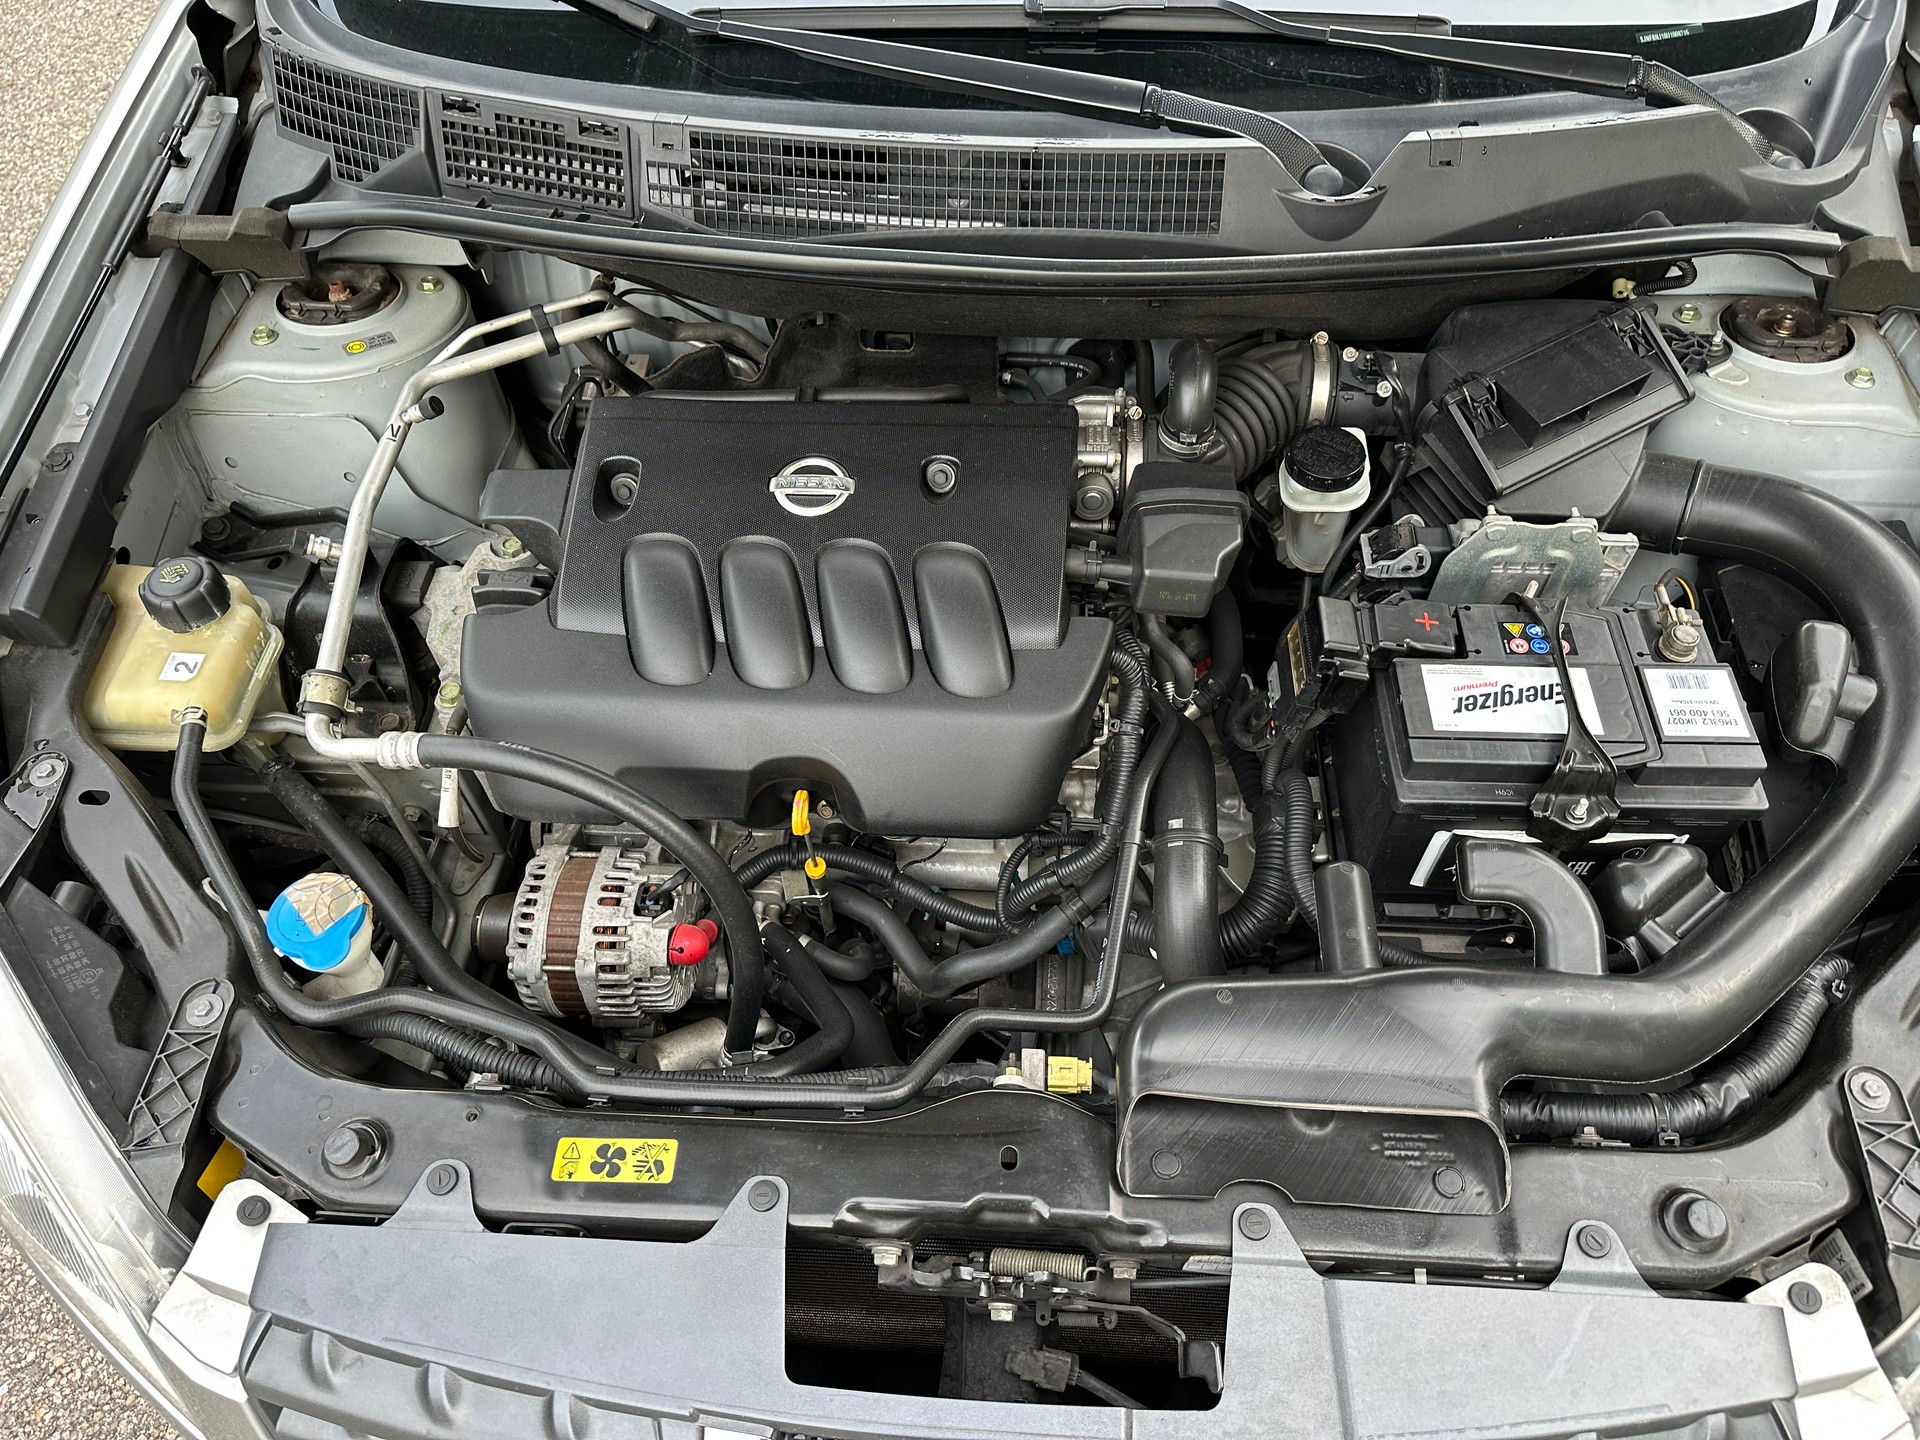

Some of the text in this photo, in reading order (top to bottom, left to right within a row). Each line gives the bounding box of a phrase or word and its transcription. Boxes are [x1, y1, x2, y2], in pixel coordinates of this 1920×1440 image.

[778, 477, 847, 490] NISSAN
[174, 661, 199, 674] 2
[1453, 680, 1498, 692] Premium
[1453, 682, 1565, 715] Energizer
[1669, 709, 1687, 717] 061
[1689, 709, 1708, 717] 400
[1667, 717, 1697, 725] UK027
